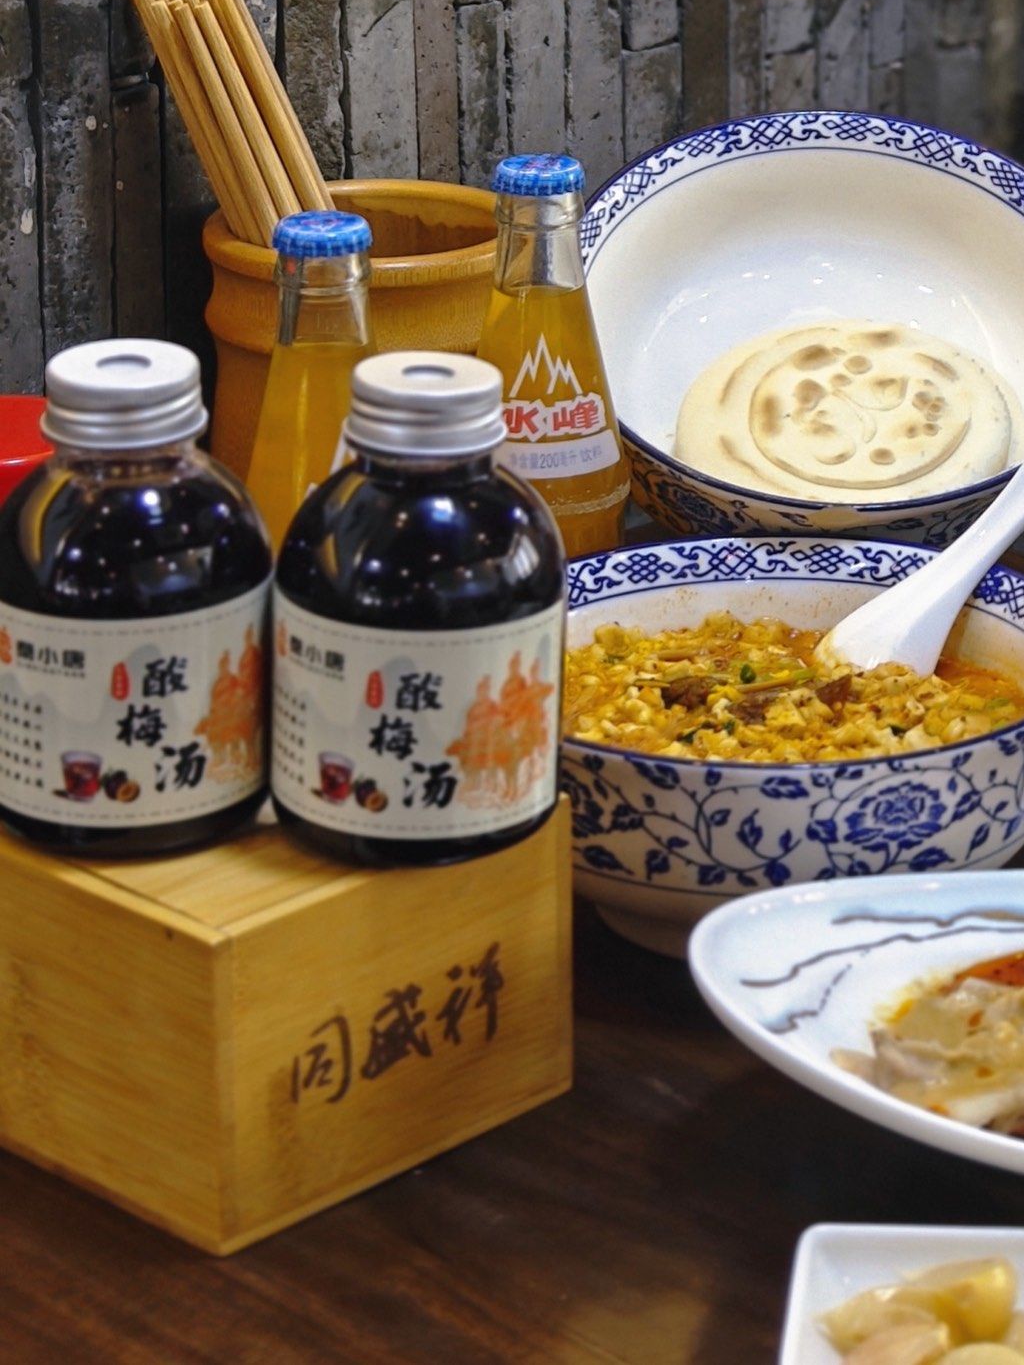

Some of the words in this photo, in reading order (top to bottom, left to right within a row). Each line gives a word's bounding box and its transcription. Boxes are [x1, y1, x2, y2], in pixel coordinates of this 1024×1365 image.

[115, 655, 207, 793] 酸梅汤
[368, 671, 458, 809] 酸梅汤
[291, 941, 505, 1104] 同盛祥
